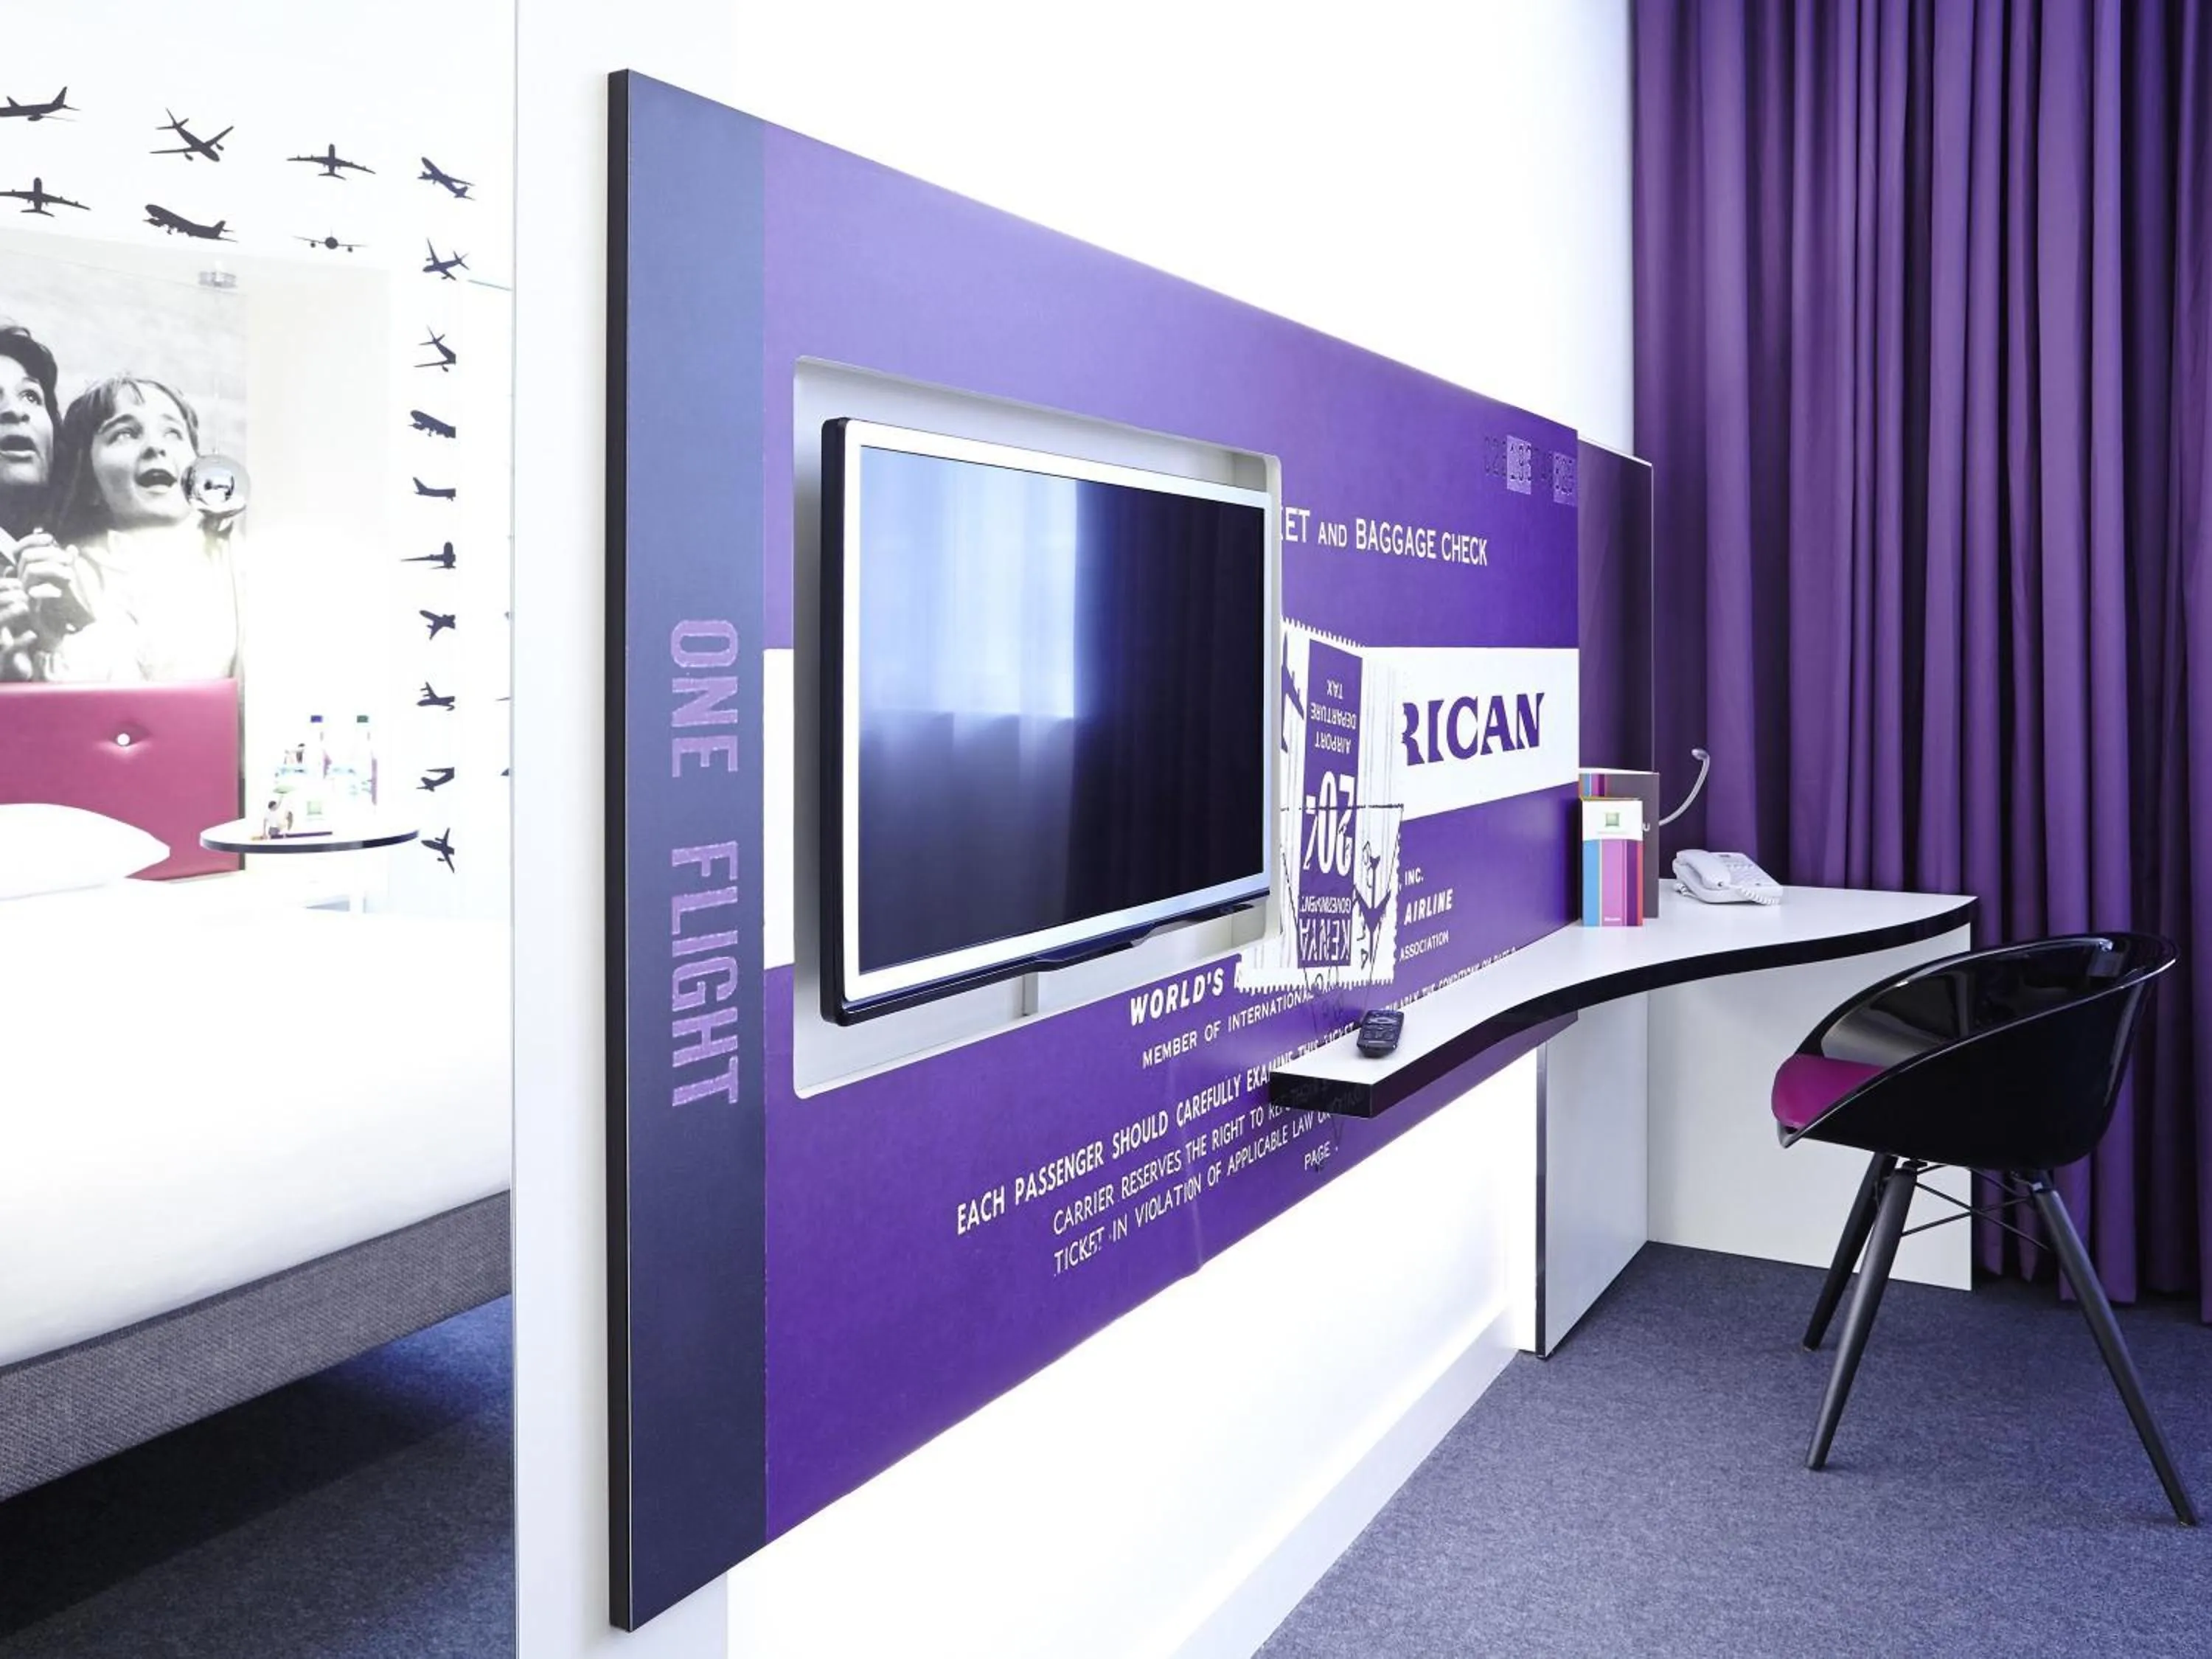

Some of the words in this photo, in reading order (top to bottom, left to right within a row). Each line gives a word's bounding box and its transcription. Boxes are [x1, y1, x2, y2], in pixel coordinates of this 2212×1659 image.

[1281, 507, 1310, 543] ET
[1318, 522, 1347, 547] AND
[1356, 518, 1436, 559] BAGGAGE
[1441, 532, 1487, 566] CHECK
[670, 619, 738, 777] ONE
[1311, 703, 1356, 729] DEPARTURE
[1327, 680, 1343, 699] TAX
[1315, 731, 1351, 754] AIRPORT
[1405, 867, 1423, 885] INC.
[672, 841, 738, 1106] FLIGHT
[1130, 967, 1224, 1026] WORLD'S
[1404, 888, 1453, 925] AIRLINE
[1299, 919, 1351, 961] KENYA
[1143, 1031, 1197, 1068] MEMBER
[1204, 1020, 1221, 1041] OF
[1228, 990, 1314, 1032] INTERNATIONAL
[1399, 930, 1449, 961] ASSOCIATION
[958, 1186, 1005, 1235] EACH
[1015, 1141, 1104, 1206] PASSENGER
[1112, 1110, 1169, 1159] SHOULD
[1177, 1074, 1241, 1127] CAREFULLY
[1054, 1183, 1114, 1235] CARRIER
[1121, 1150, 1182, 1200] RESERVES
[1186, 1135, 1206, 1164] THE
[1212, 1115, 1245, 1151] RIGHT
[1249, 1105, 1264, 1130] TO
[1054, 1227, 1105, 1274] TICKET
[1113, 1214, 1127, 1242] IN
[1135, 1173, 1201, 1228] VIOLATION
[1208, 1162, 1221, 1186] OF
[1227, 1124, 1288, 1176] APPLICABLE
[1293, 1110, 1314, 1138] LAW
[1304, 1141, 1330, 1171] PAGE
